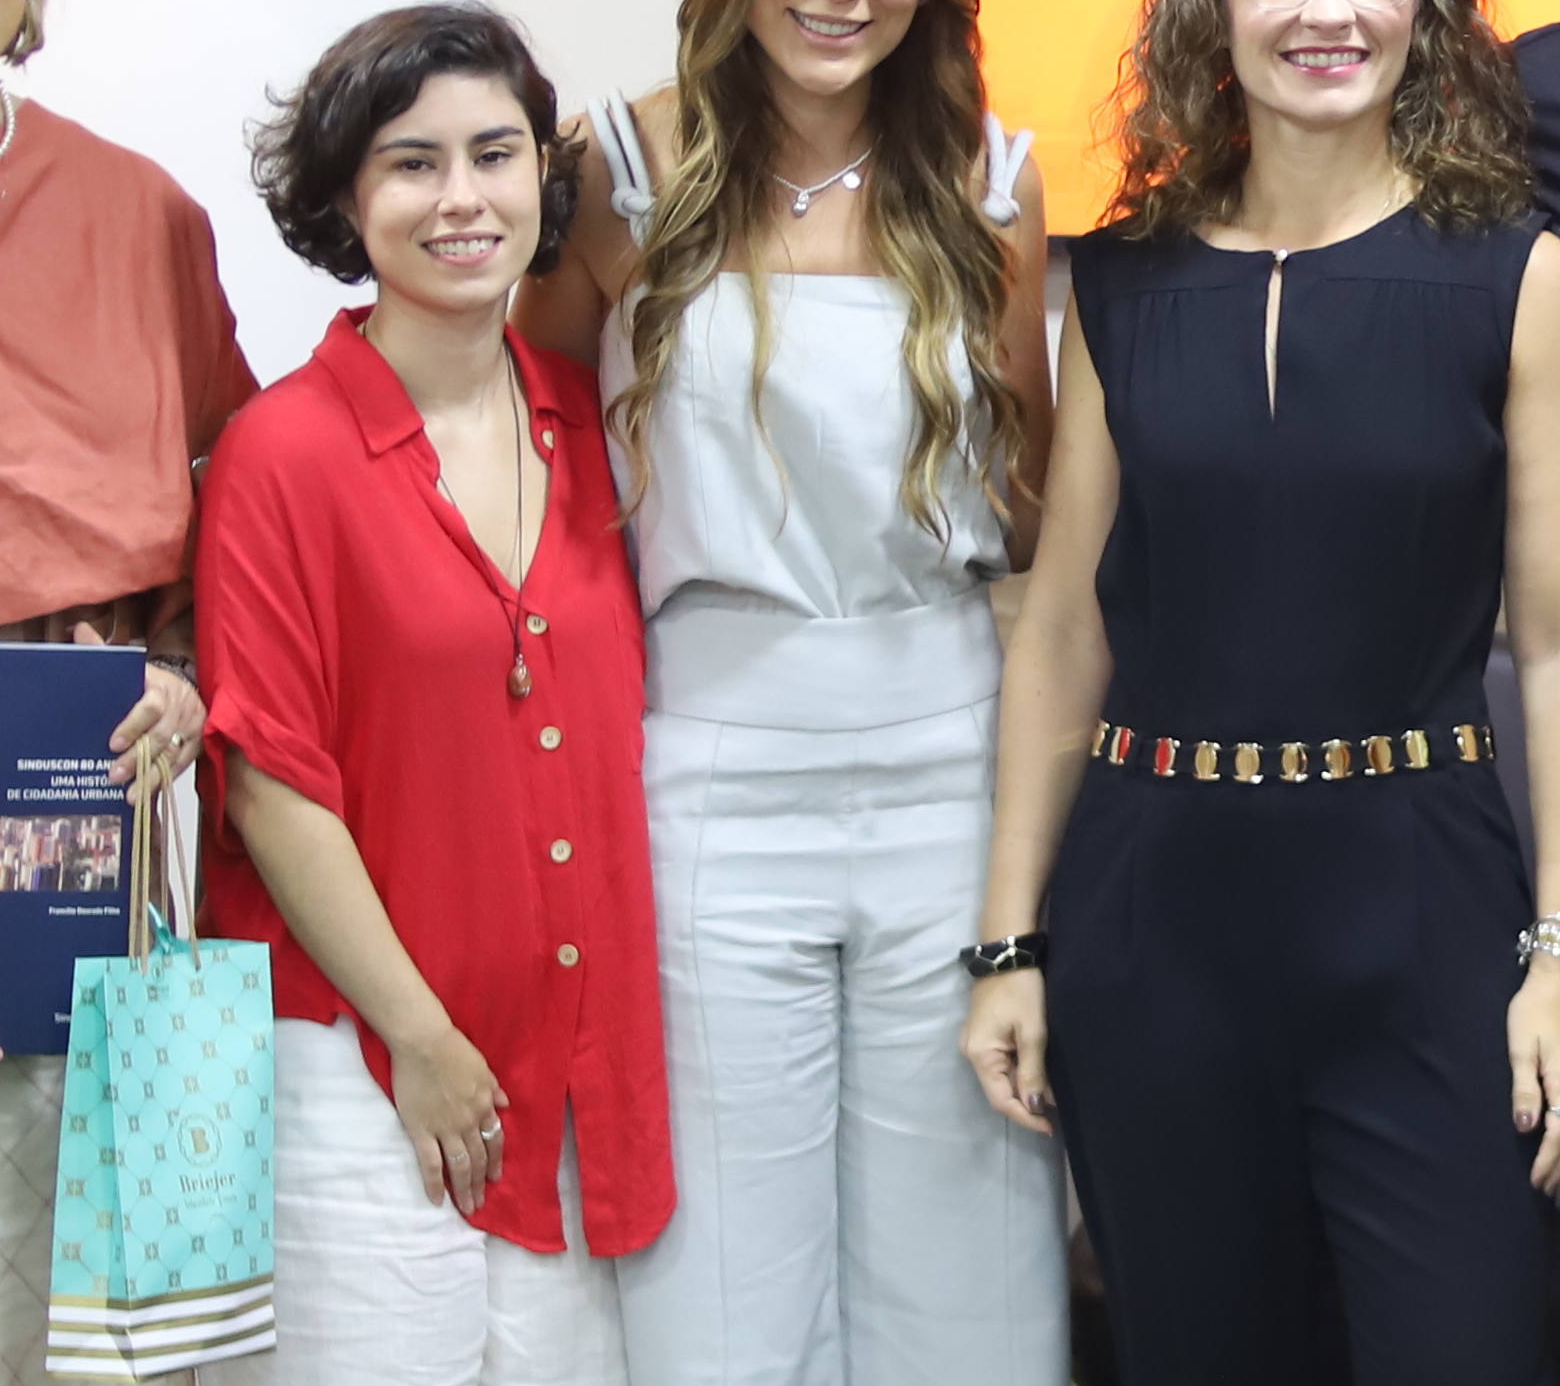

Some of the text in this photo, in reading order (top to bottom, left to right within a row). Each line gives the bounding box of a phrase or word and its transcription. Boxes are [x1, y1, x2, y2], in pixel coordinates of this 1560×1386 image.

[16, 758, 79, 772] SINDUSCON
[50, 775, 76, 787] UMA
[6, 788, 125, 801] DE CIDADANIA URBANA
